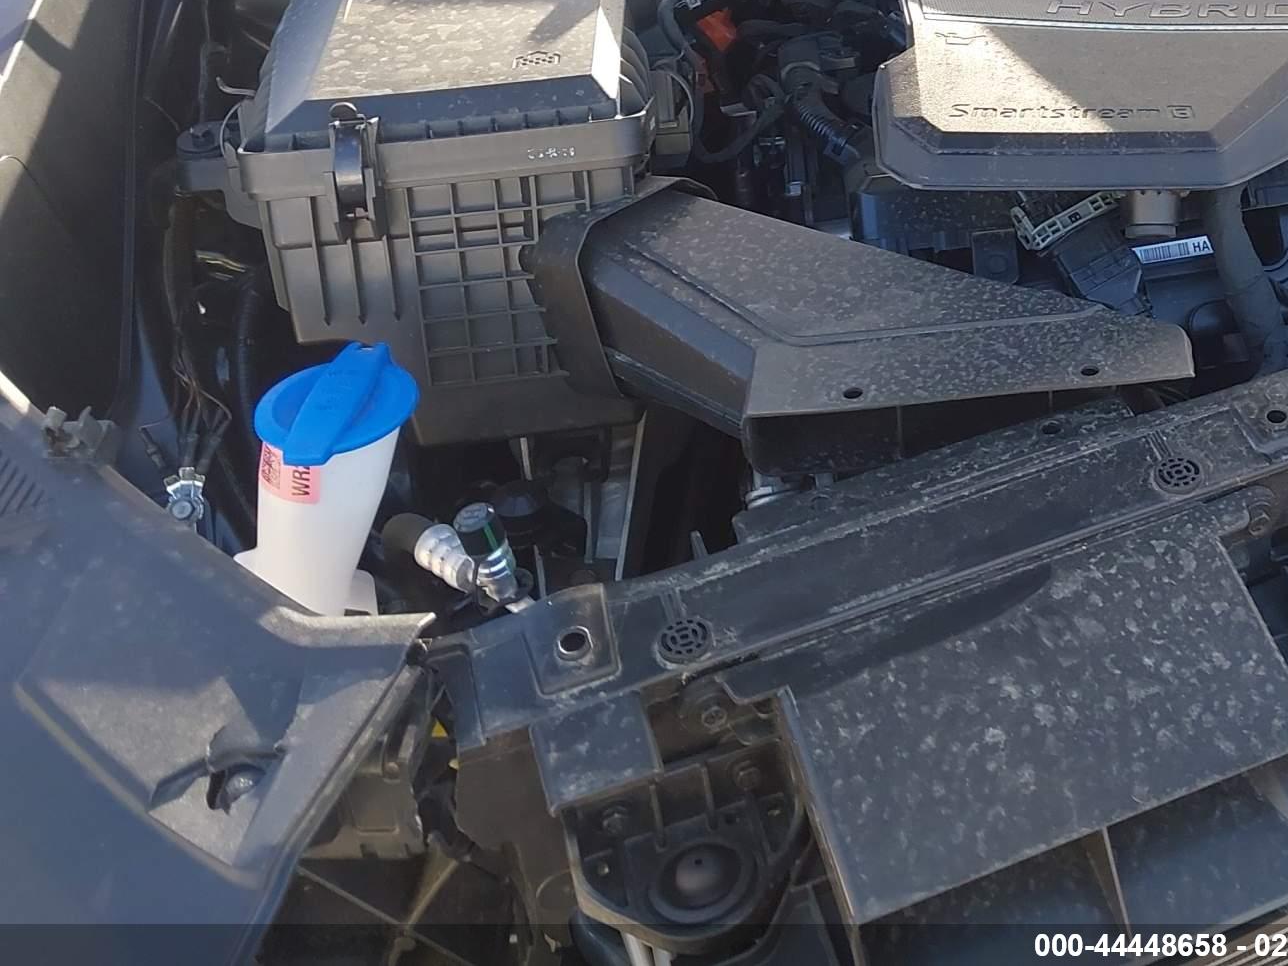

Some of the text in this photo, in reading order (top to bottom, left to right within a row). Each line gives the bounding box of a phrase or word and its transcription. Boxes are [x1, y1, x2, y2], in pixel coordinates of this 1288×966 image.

[949, 103, 1160, 120] Smartstream
[1192, 240, 1210, 253] HA
[291, 466, 311, 496] WR
